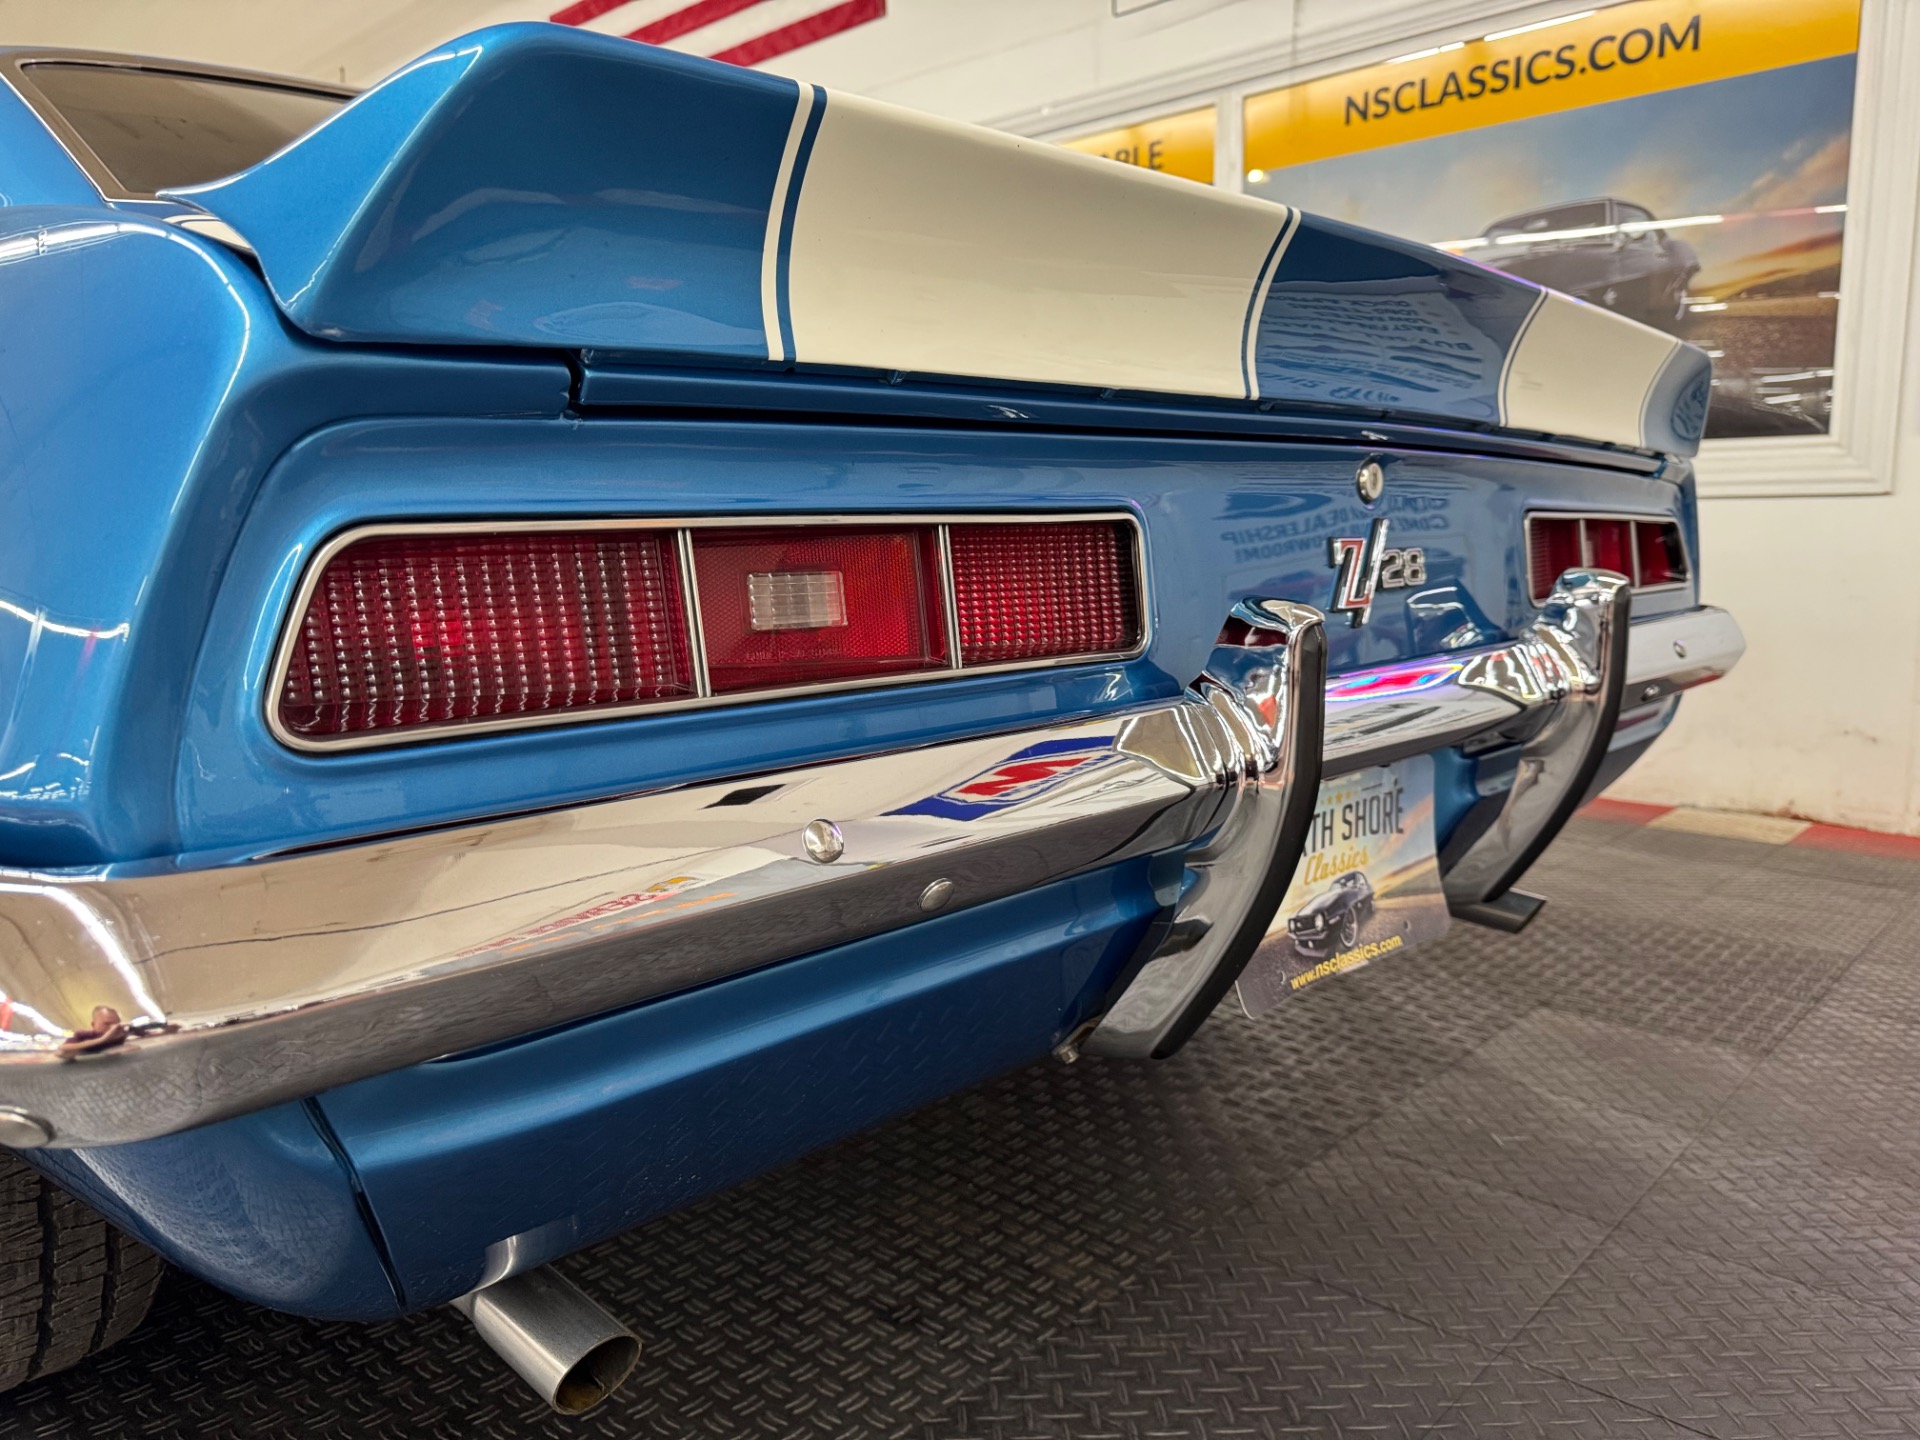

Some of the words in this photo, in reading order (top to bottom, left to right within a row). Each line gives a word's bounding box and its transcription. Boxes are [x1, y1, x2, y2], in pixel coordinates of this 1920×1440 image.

[1344, 15, 1701, 125] NSCLASSICS.COM
[1341, 787, 1404, 840] SHORE
[1303, 848, 1369, 886] Classics
[1290, 935, 1402, 989] www.nsclassics.com
